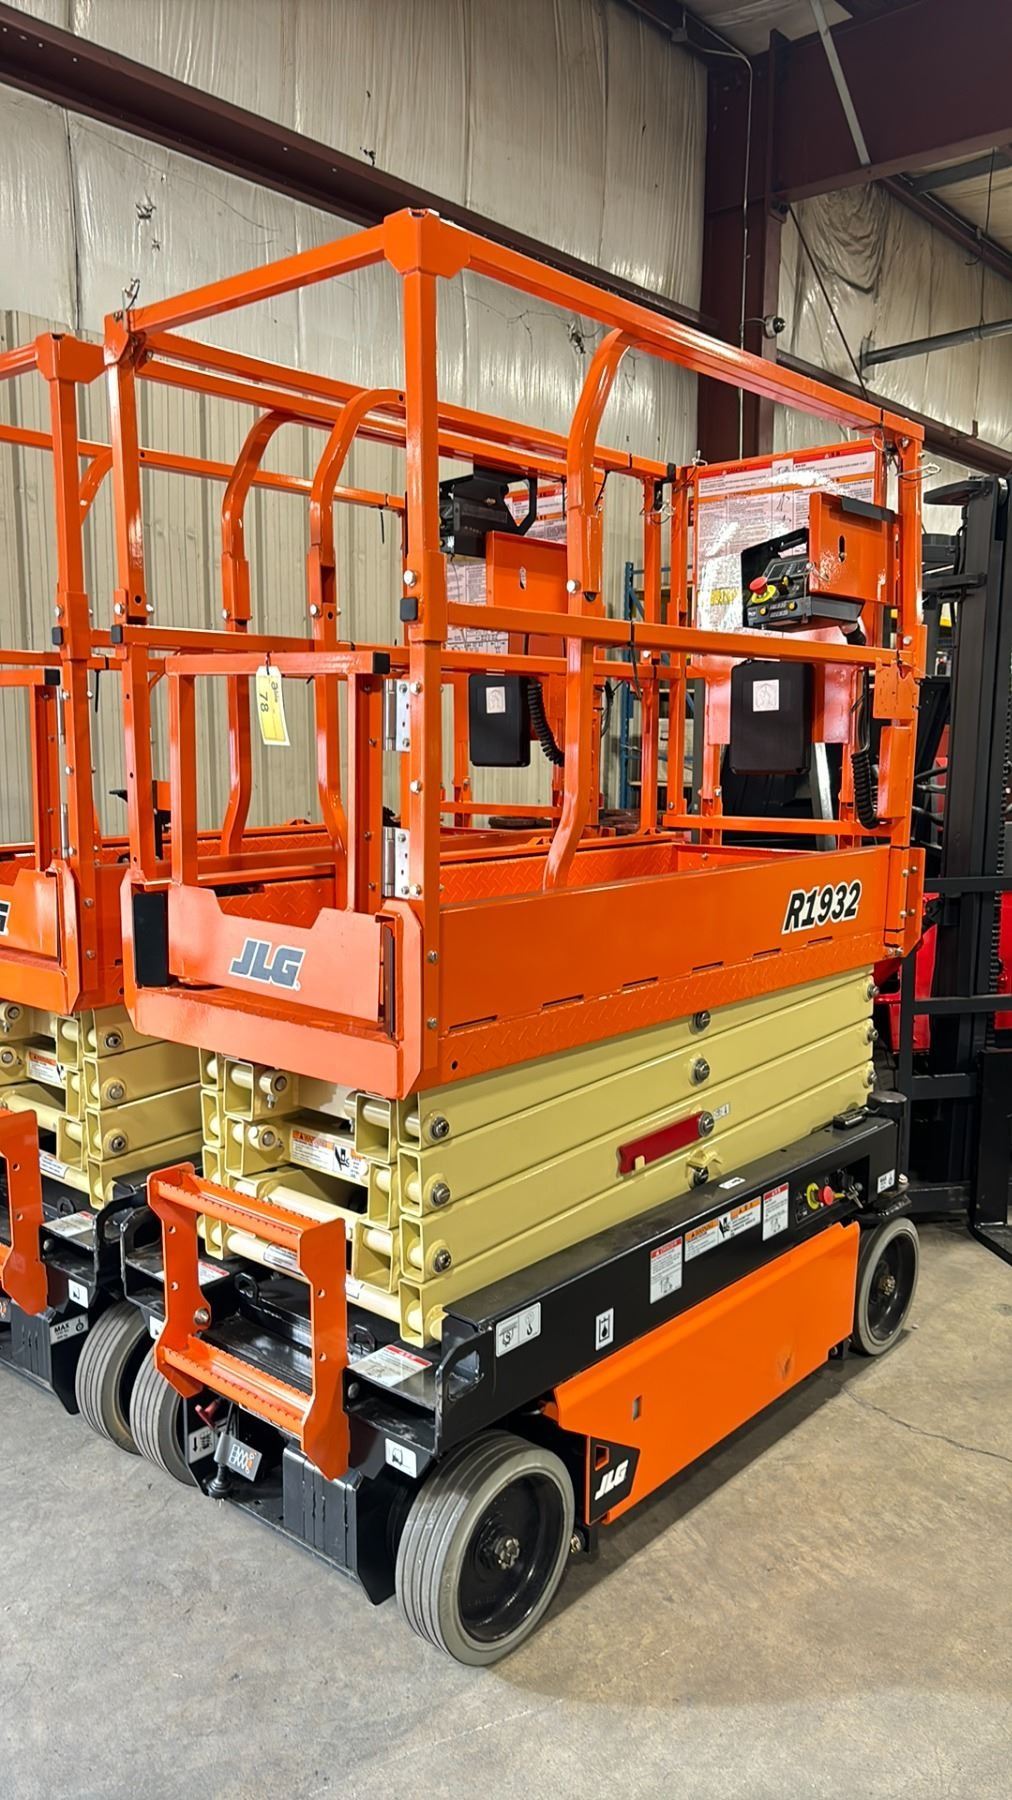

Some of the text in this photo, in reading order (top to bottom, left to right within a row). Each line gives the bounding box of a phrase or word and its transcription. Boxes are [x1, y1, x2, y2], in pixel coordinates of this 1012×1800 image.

[782, 880, 862, 935] R1932
[228, 937, 306, 989] JLG
[594, 1459, 629, 1501] JLG
